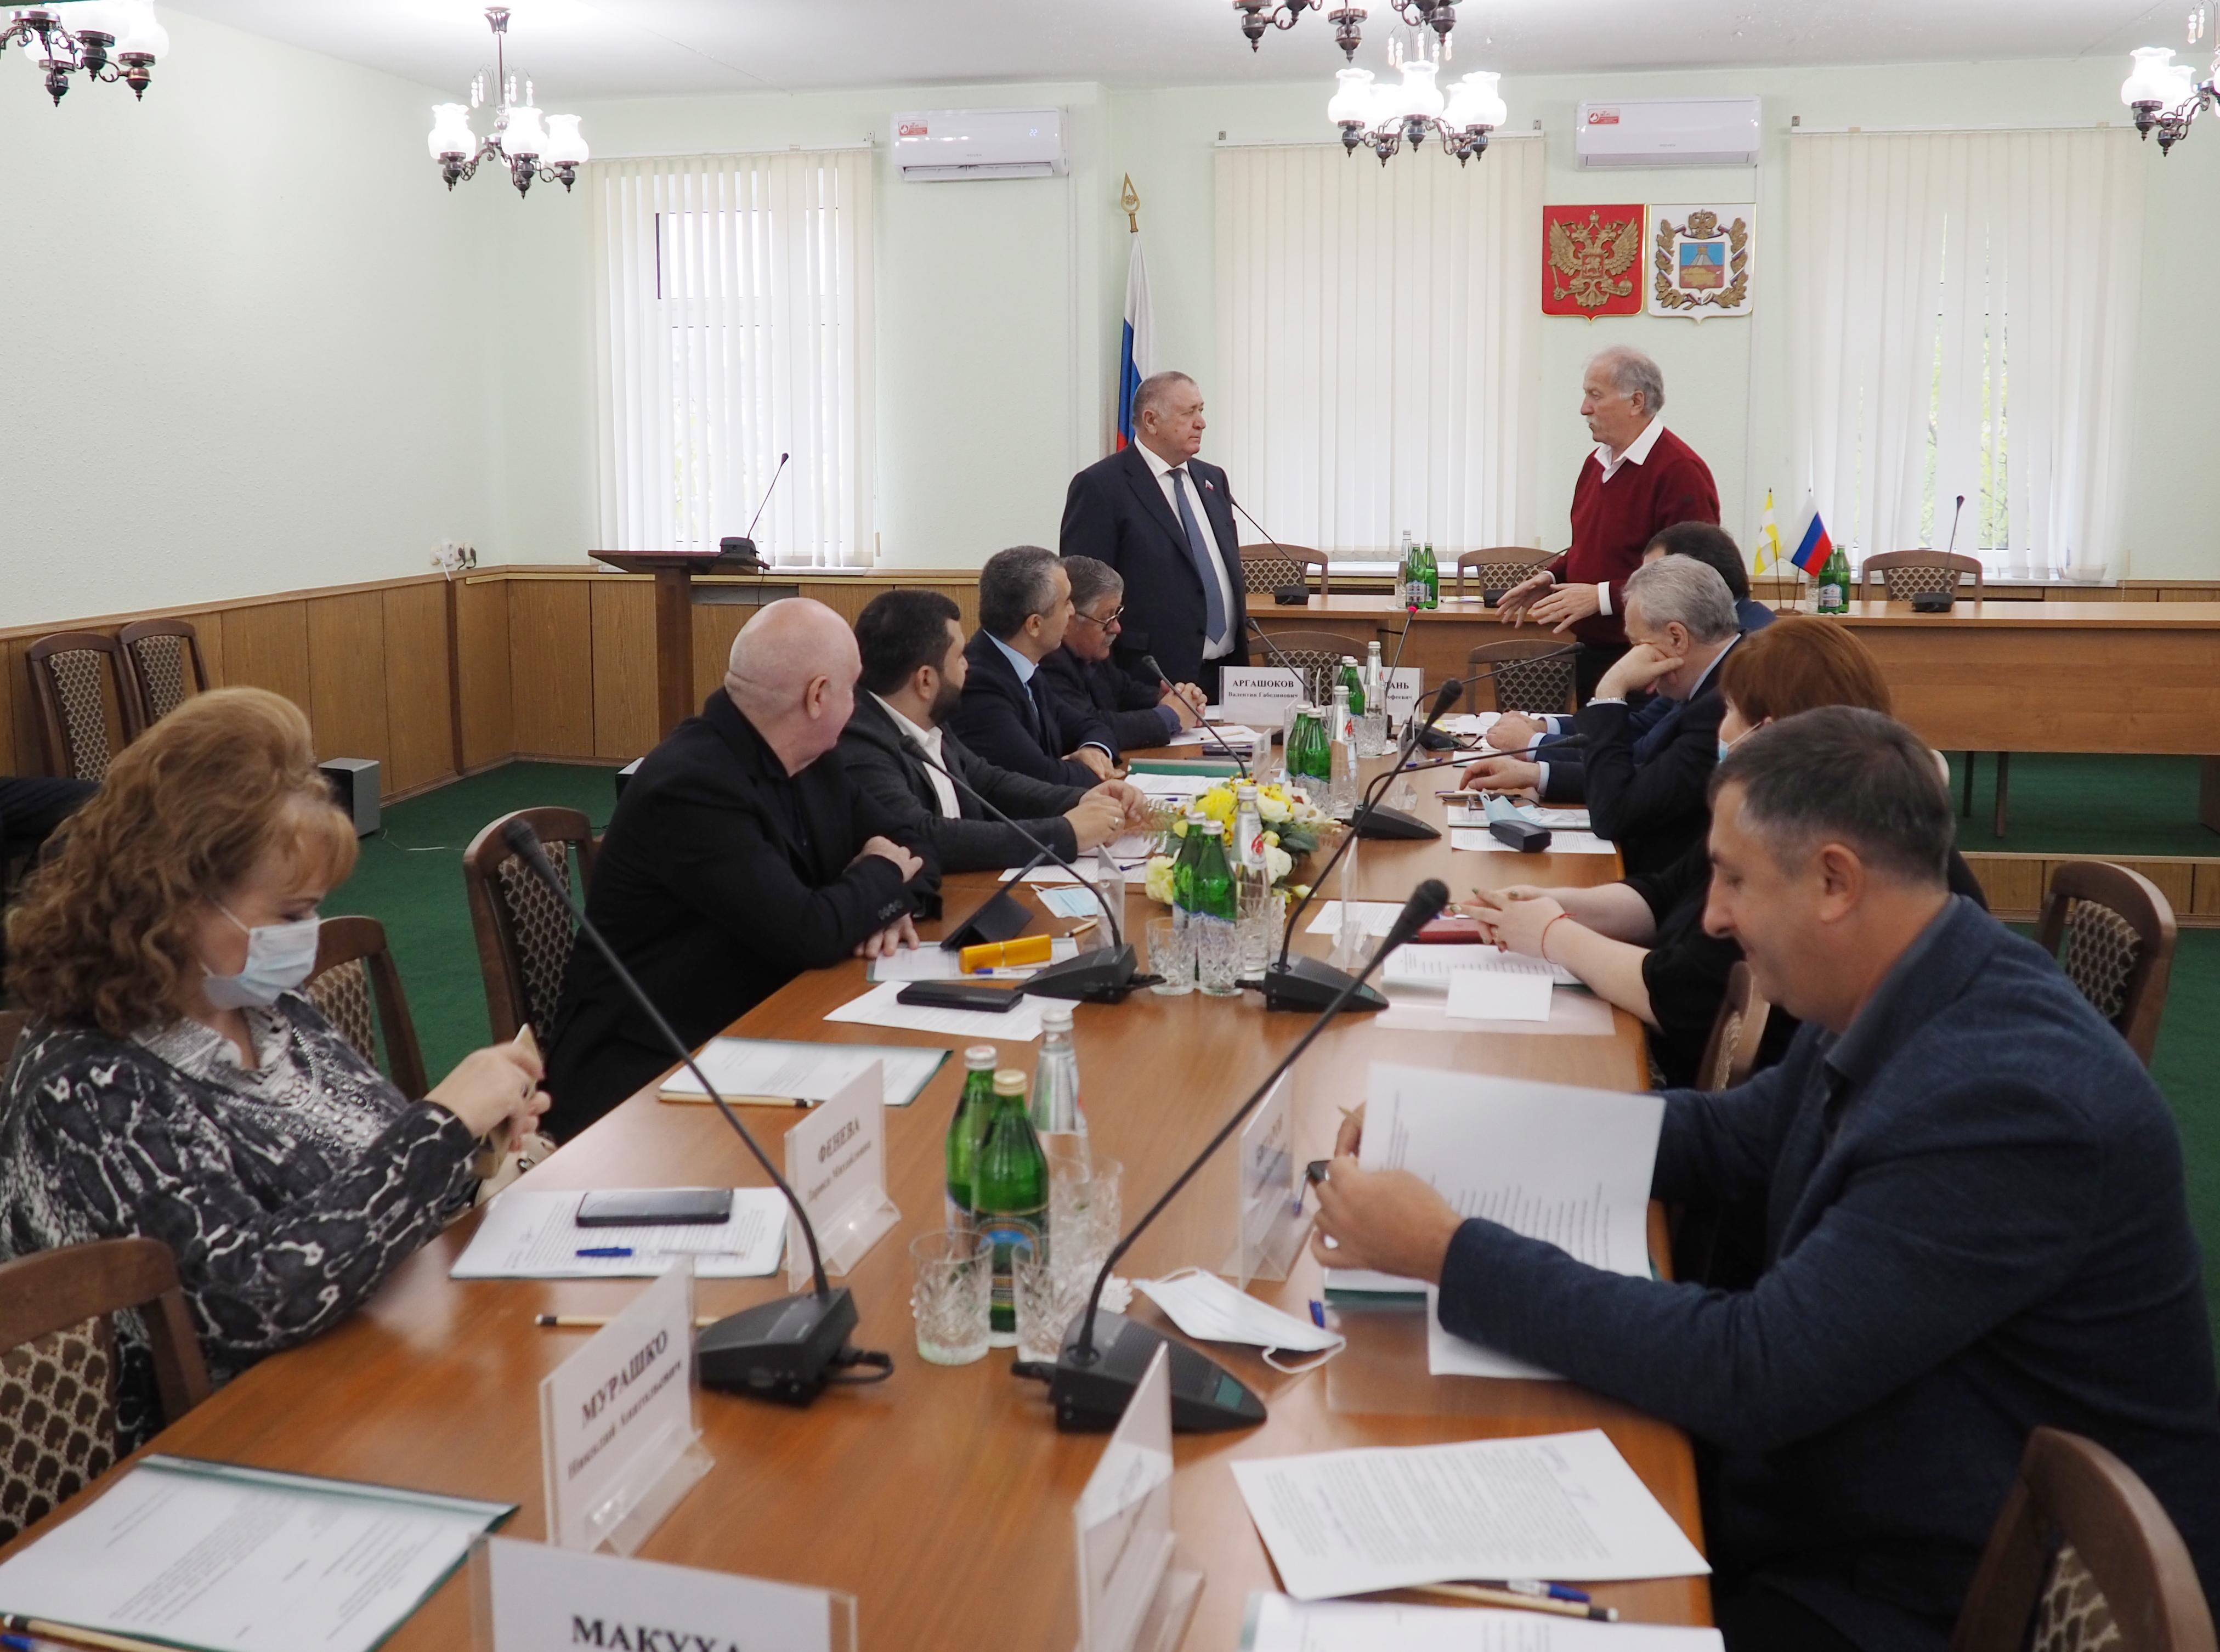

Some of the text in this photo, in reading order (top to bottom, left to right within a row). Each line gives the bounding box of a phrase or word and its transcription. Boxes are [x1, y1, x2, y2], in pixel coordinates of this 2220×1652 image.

[1029, 128, 1038, 137] 22
[818, 1117, 860, 1163] ФЕНЕВА
[582, 1329, 668, 1430] МУРАШКО
